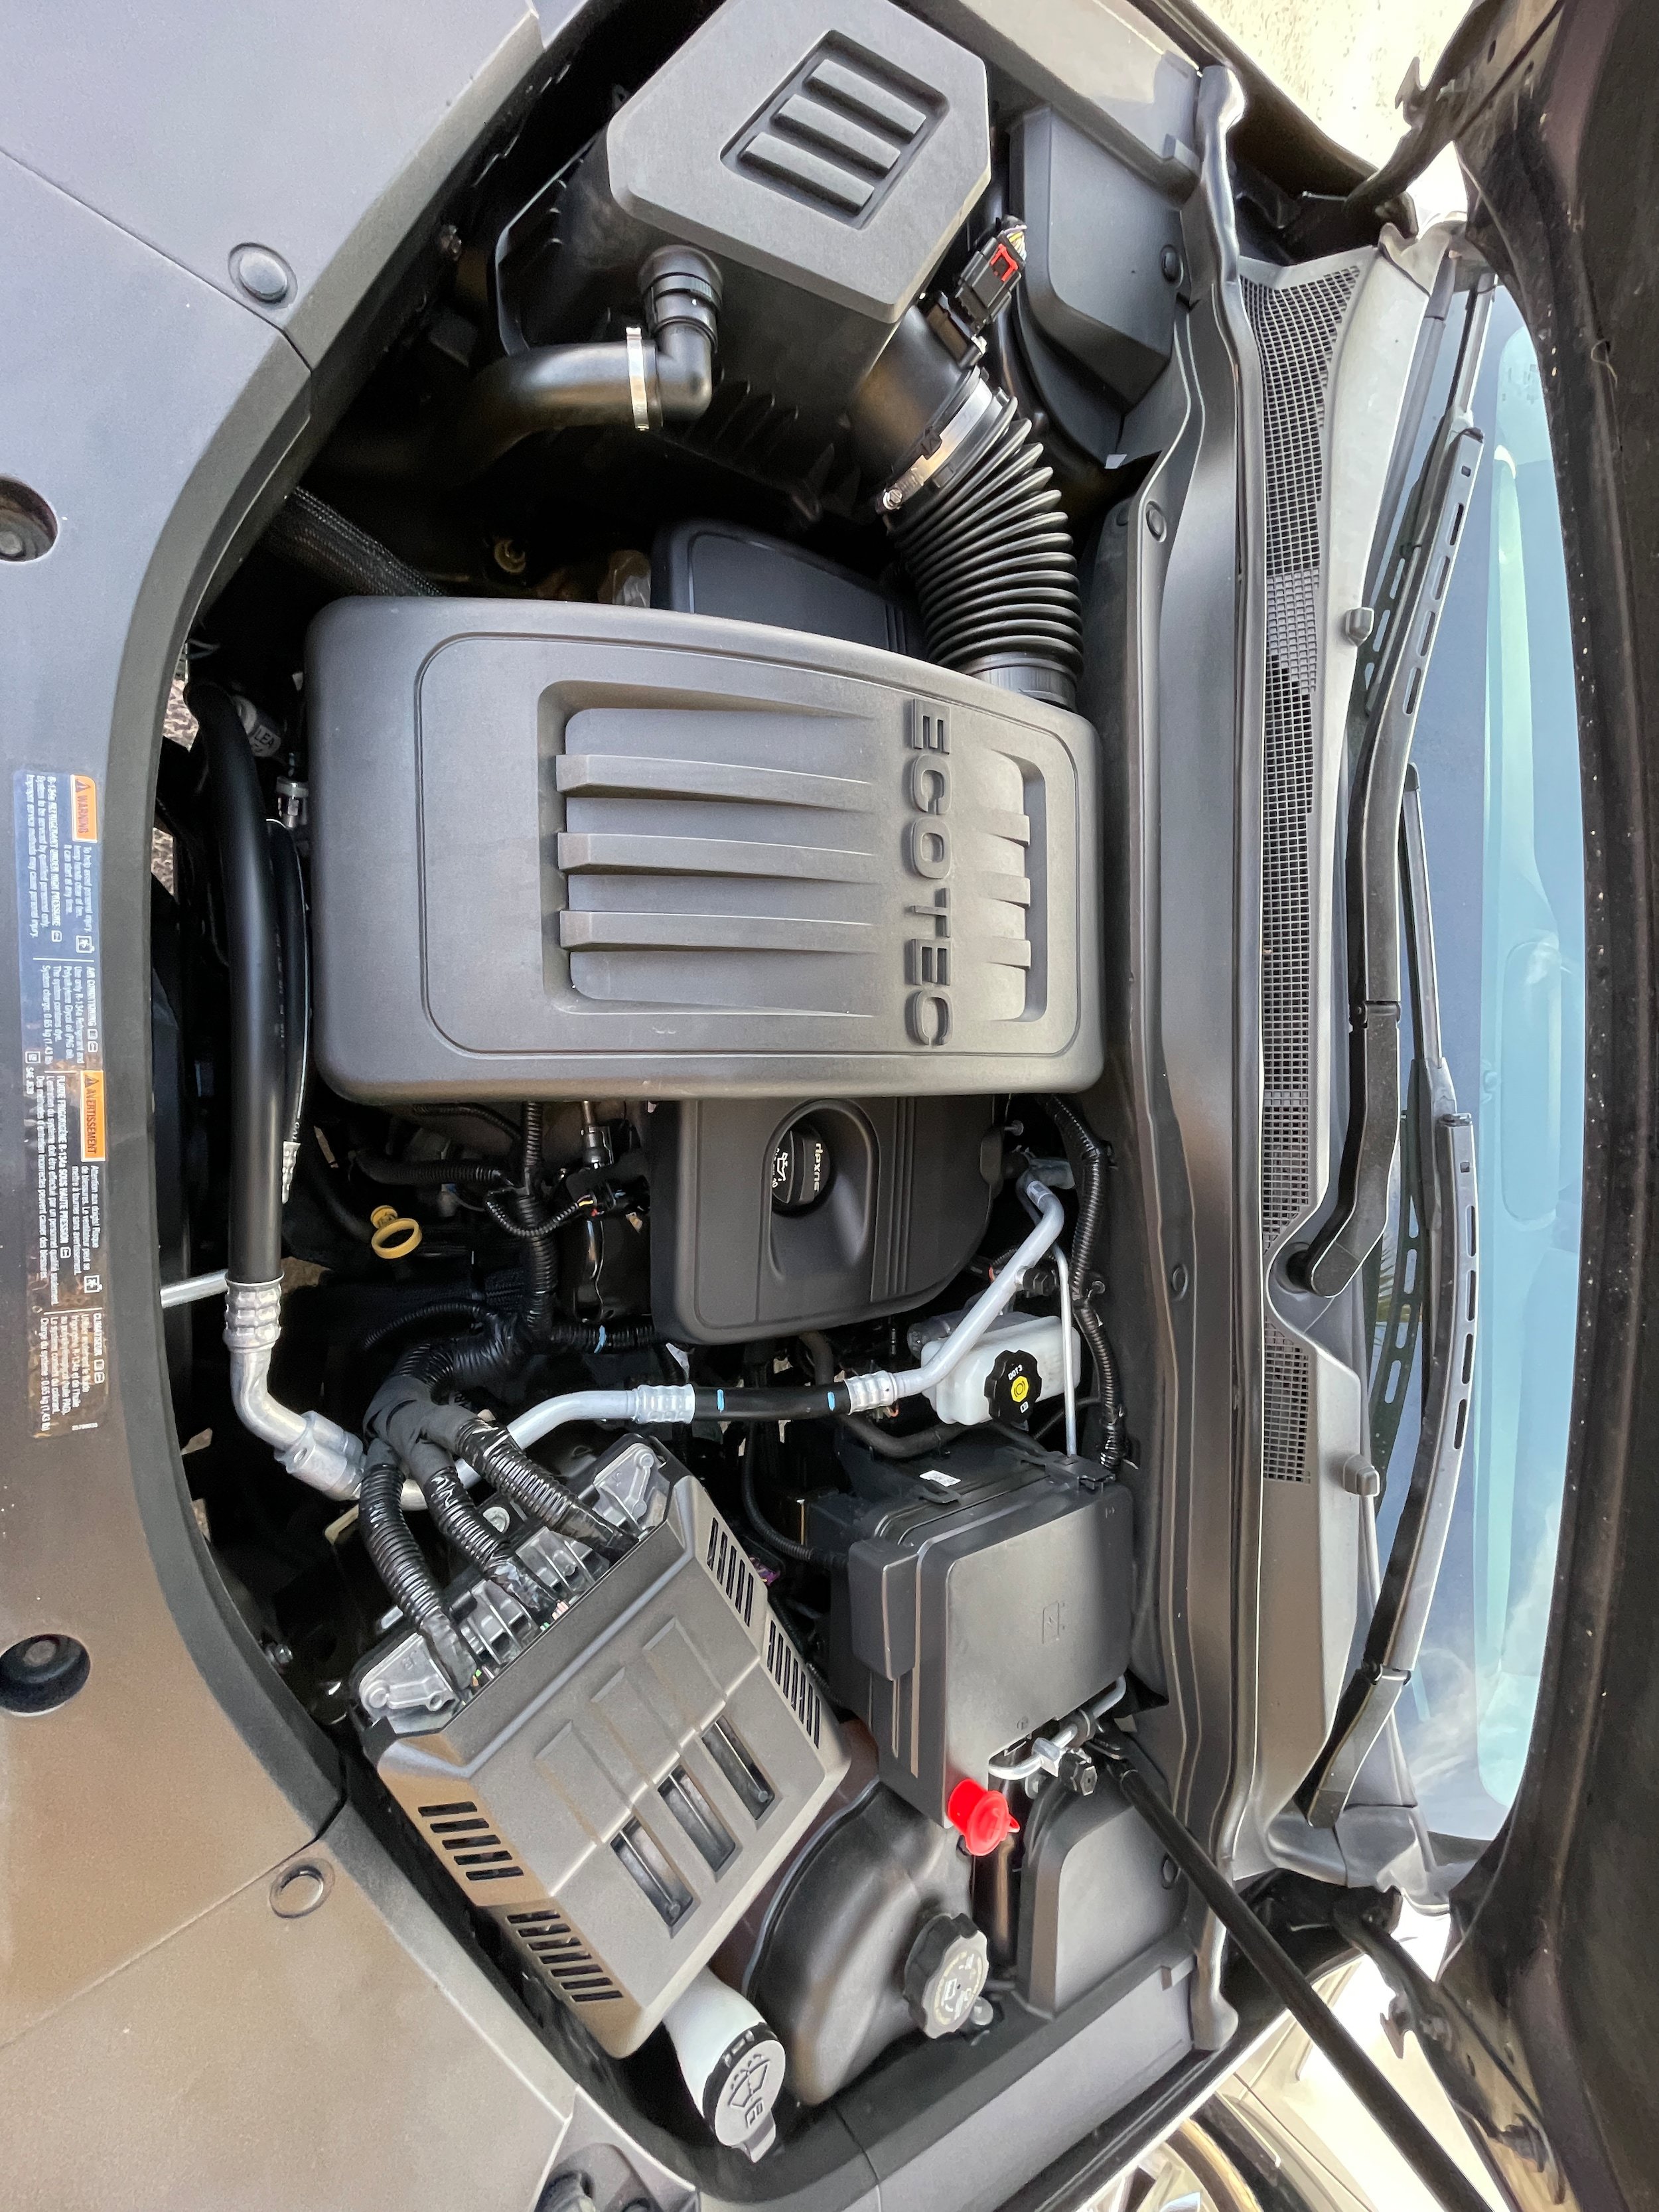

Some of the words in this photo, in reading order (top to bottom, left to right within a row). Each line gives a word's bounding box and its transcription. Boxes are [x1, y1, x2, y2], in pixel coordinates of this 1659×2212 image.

[907, 698, 954, 1046] ECOTEC
[86, 1088, 96, 1153] AVERTISSEMENT
[59, 1169, 68, 1187] SOUS
[60, 1211, 68, 1243] PRESSION
